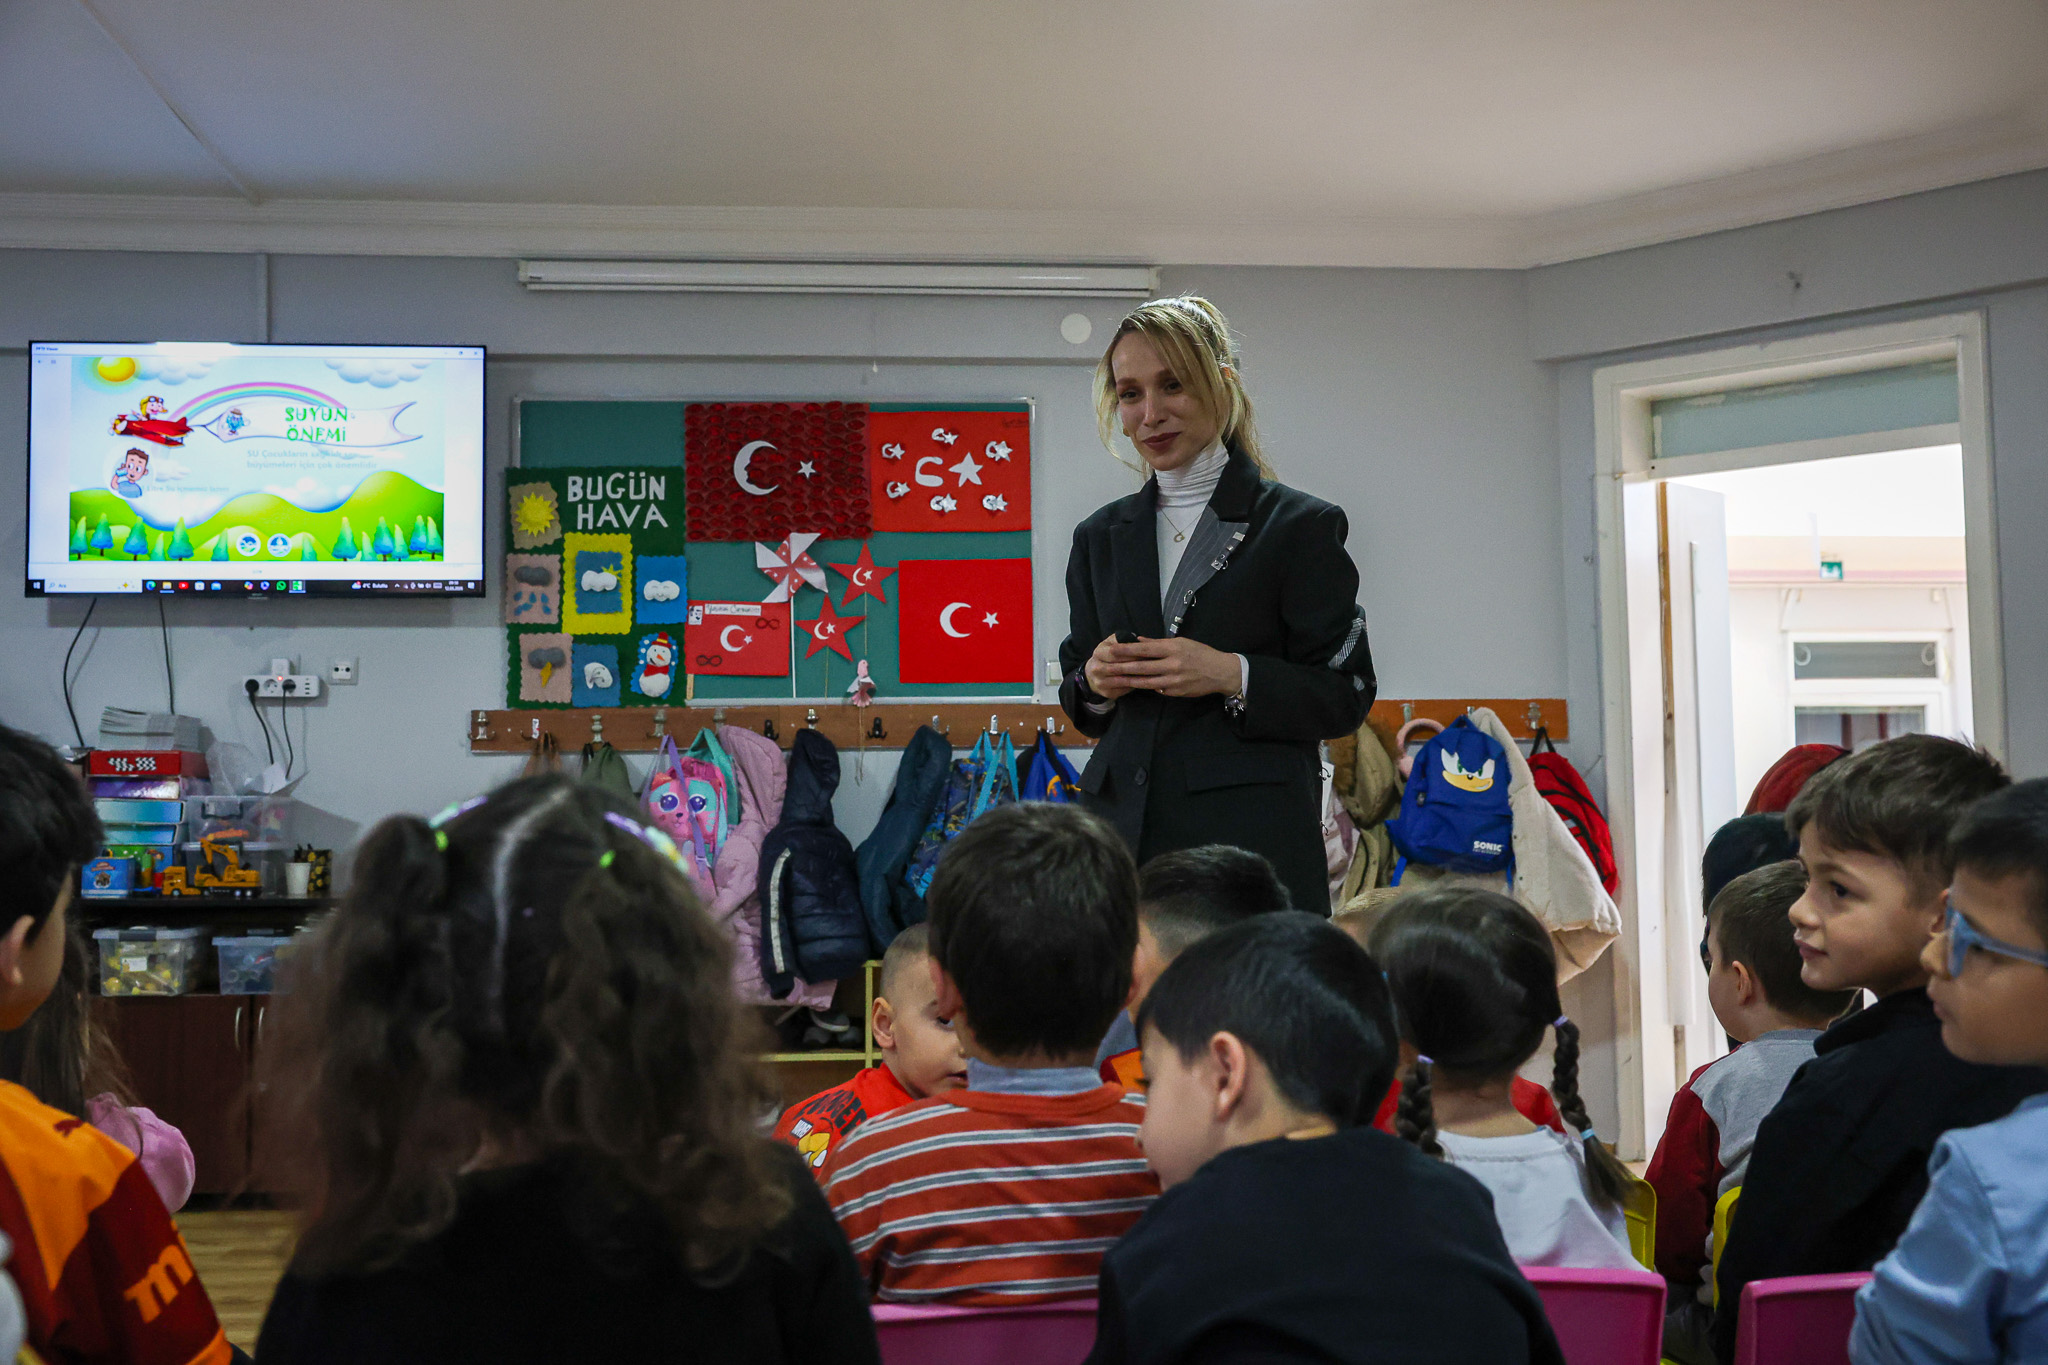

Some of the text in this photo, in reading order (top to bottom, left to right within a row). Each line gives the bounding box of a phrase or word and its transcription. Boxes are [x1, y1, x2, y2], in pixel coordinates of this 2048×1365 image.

[285, 406, 348, 422] SUYUN
[567, 471, 665, 502] BUGÜN
[577, 502, 669, 530] HAVA
[1473, 840, 1502, 852] SONIC
